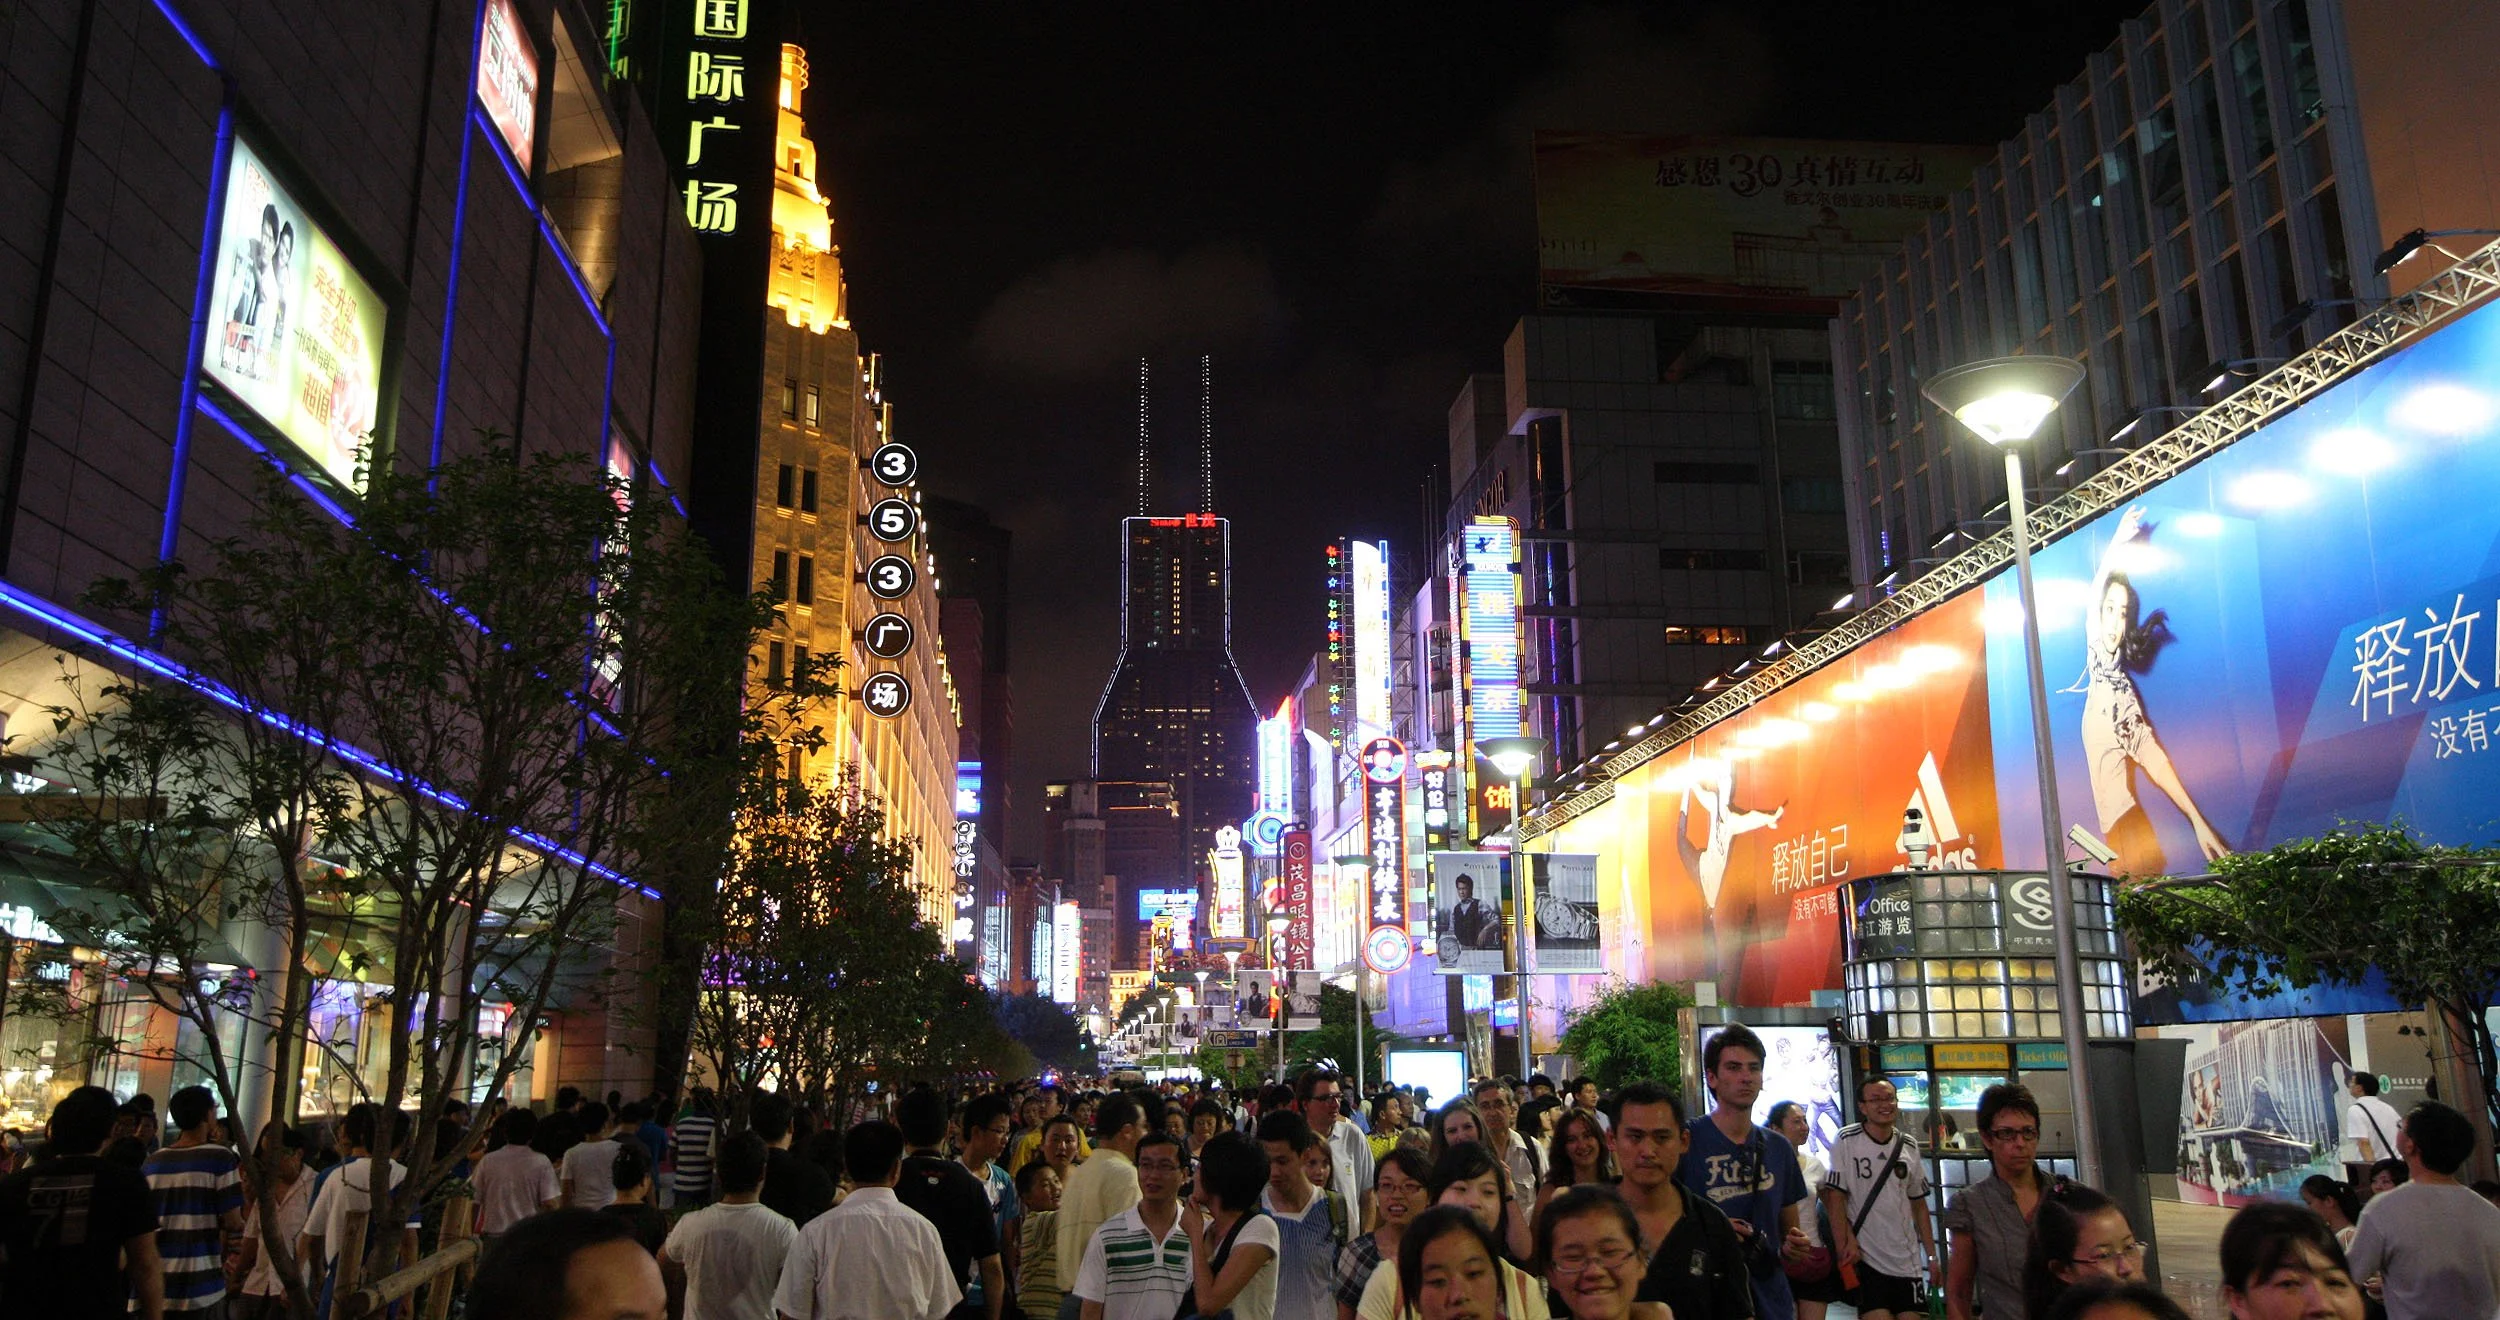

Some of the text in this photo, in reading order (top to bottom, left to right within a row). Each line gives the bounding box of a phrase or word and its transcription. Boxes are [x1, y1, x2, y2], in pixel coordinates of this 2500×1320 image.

[683, 0, 748, 233] 国际广场
[1184, 512, 1216, 528] 世茂
[2350, 593, 2500, 723] 释放
[1771, 824, 1849, 896] 释放自己
[1794, 890, 1837, 921] 没有不可能
[1870, 897, 1911, 915] Office
[1853, 1156, 1873, 1180] 13
